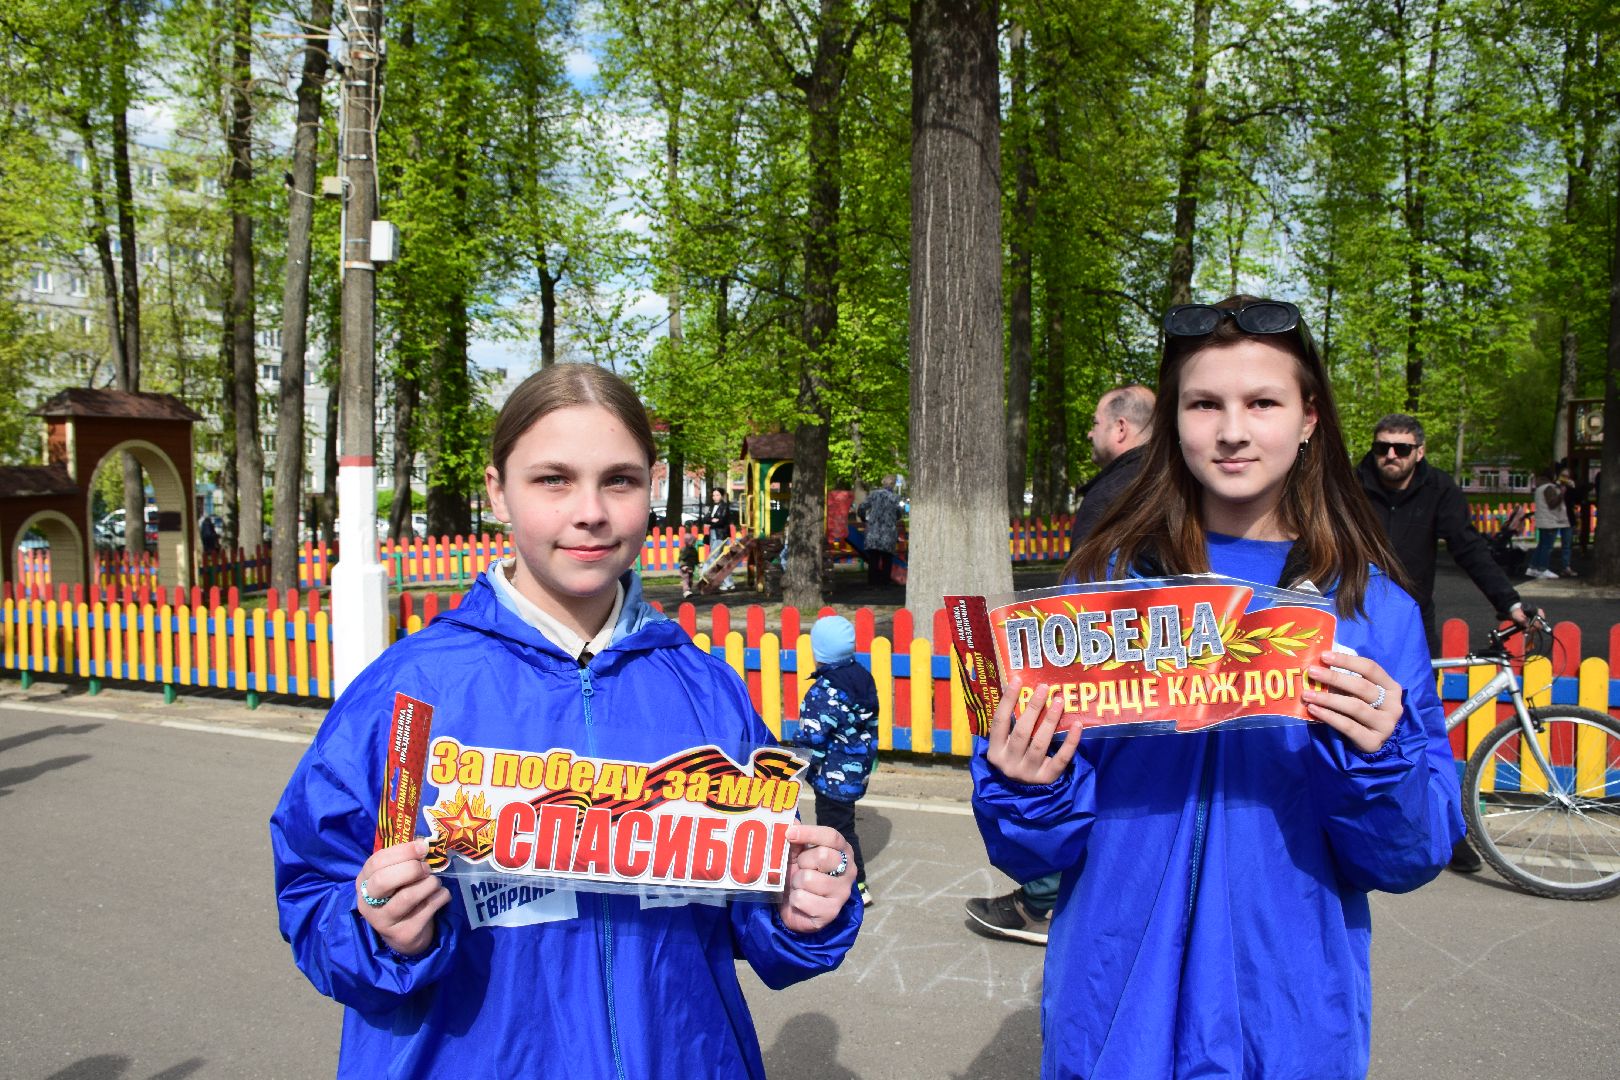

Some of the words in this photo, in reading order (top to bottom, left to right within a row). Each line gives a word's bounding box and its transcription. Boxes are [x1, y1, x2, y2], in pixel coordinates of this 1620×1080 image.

[953, 606, 965, 641] НАКЛЕЙКА
[959, 599, 974, 648] ПРАЗДНИЧНАЯ
[1005, 602, 1225, 670] ПОБЕДА
[974, 651, 987, 685] ПОМНИТ
[394, 709, 406, 753] НАКЛЕЙКА
[399, 703, 414, 764] ПРАЗДНИЧНАЯ
[397, 767, 410, 811] ПОМНИТ
[431, 741, 485, 786] За
[492, 752, 653, 802] победу,
[662, 770, 711, 802] за
[710, 774, 801, 811] мир
[493, 801, 790, 887] СПАСИБО!
[475, 885, 556, 923] ГВАРДИ
